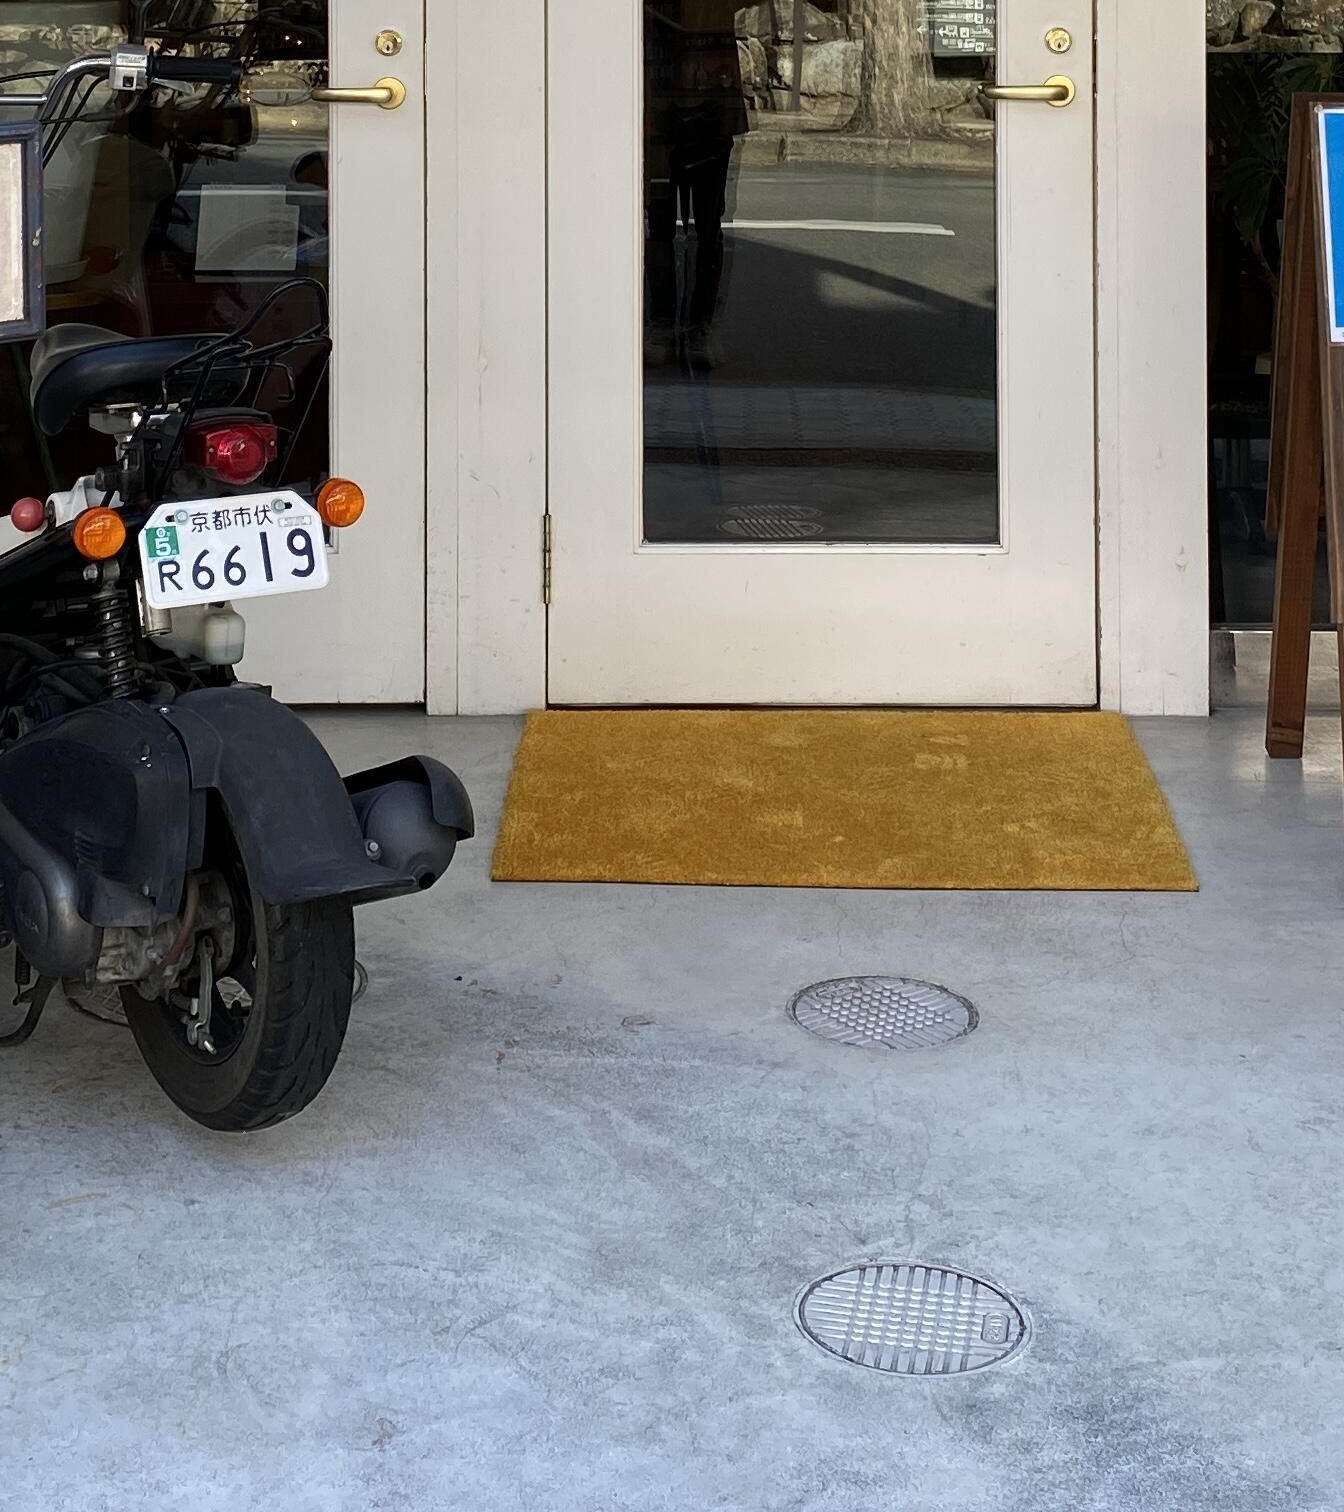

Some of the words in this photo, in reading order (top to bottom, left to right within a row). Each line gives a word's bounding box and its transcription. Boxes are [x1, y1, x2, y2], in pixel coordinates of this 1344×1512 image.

[189, 505, 273, 533] 京都市伏
[154, 537, 172, 556] 5
